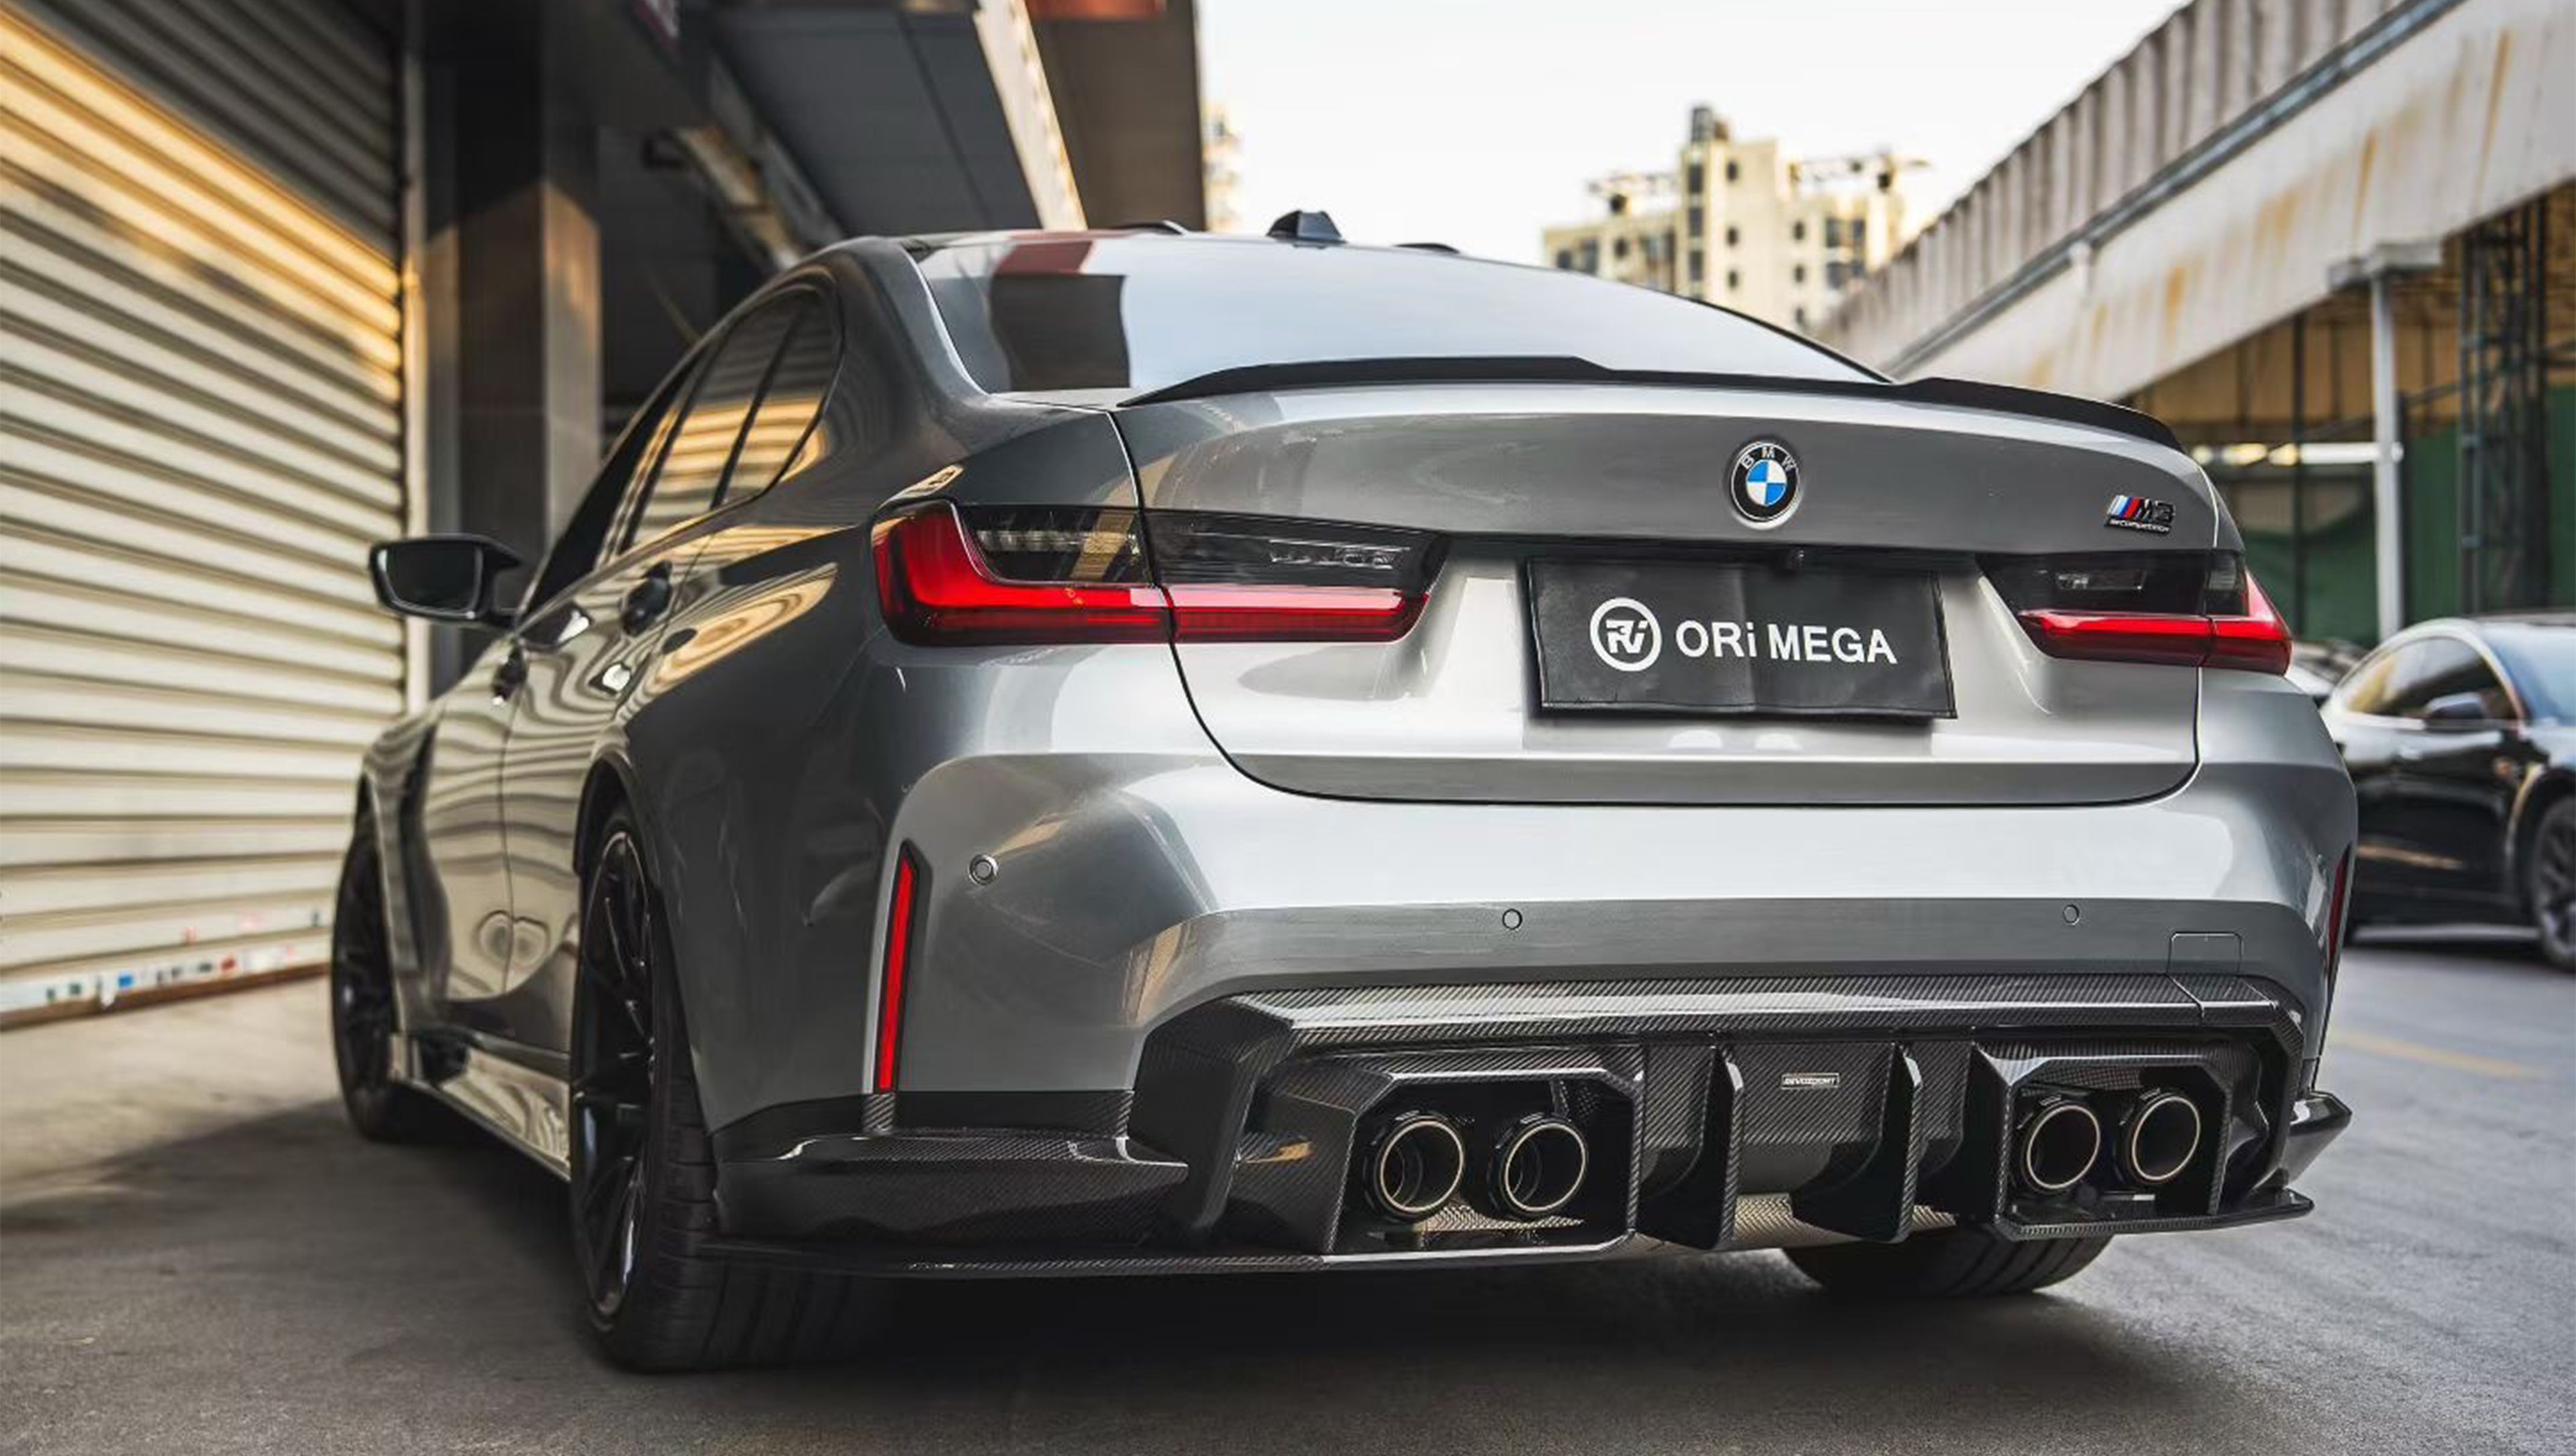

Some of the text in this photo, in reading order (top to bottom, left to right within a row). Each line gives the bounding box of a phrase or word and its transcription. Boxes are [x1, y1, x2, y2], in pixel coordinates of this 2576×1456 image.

[1740, 446, 1796, 471] BMW
[1676, 620, 1757, 657] ORi
[1768, 624, 1898, 664] MEGA
